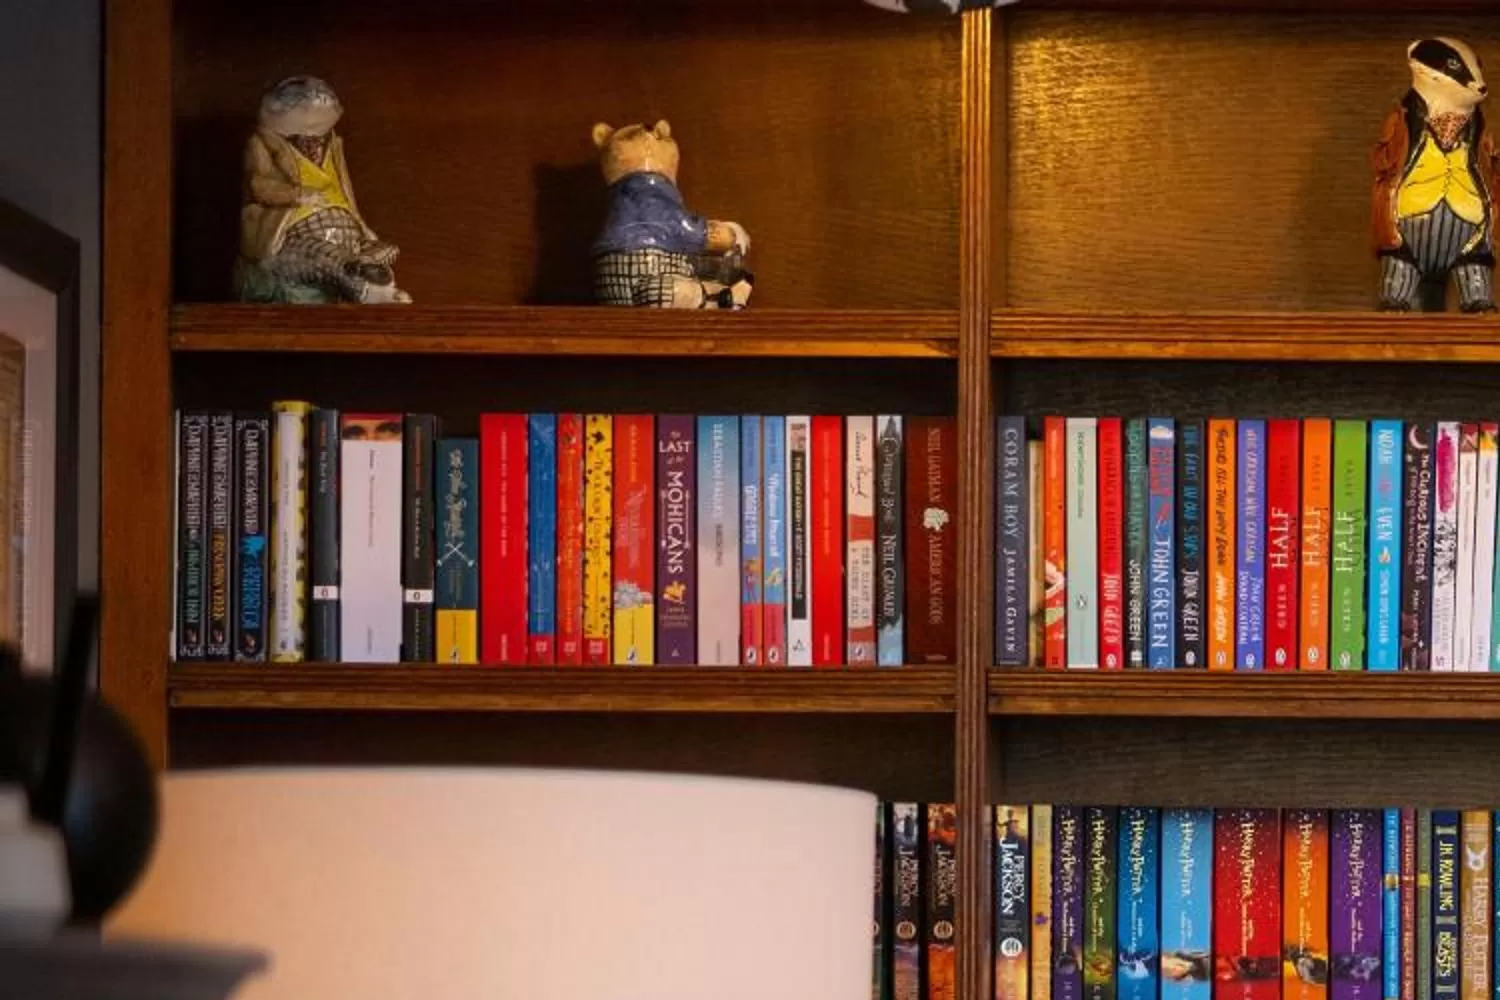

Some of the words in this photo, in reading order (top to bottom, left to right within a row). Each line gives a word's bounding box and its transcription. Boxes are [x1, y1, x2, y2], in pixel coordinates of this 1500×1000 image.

[1003, 428, 1018, 496] CORAM
[667, 471, 684, 573] MOHICANS
[1003, 504, 1018, 538] BOY
[1270, 506, 1289, 569] HALF
[1303, 507, 1321, 567] HALF
[1334, 511, 1352, 572] HALF
[1003, 548, 1016, 603] JAMILA
[1129, 560, 1140, 596] JOHN
[1130, 600, 1141, 641] GREEN
[1152, 588, 1169, 648] GREEN
[999, 840, 1016, 915] JACKSON
[1013, 856, 1025, 903] PERCY
[1472, 878, 1488, 925] HARRY
